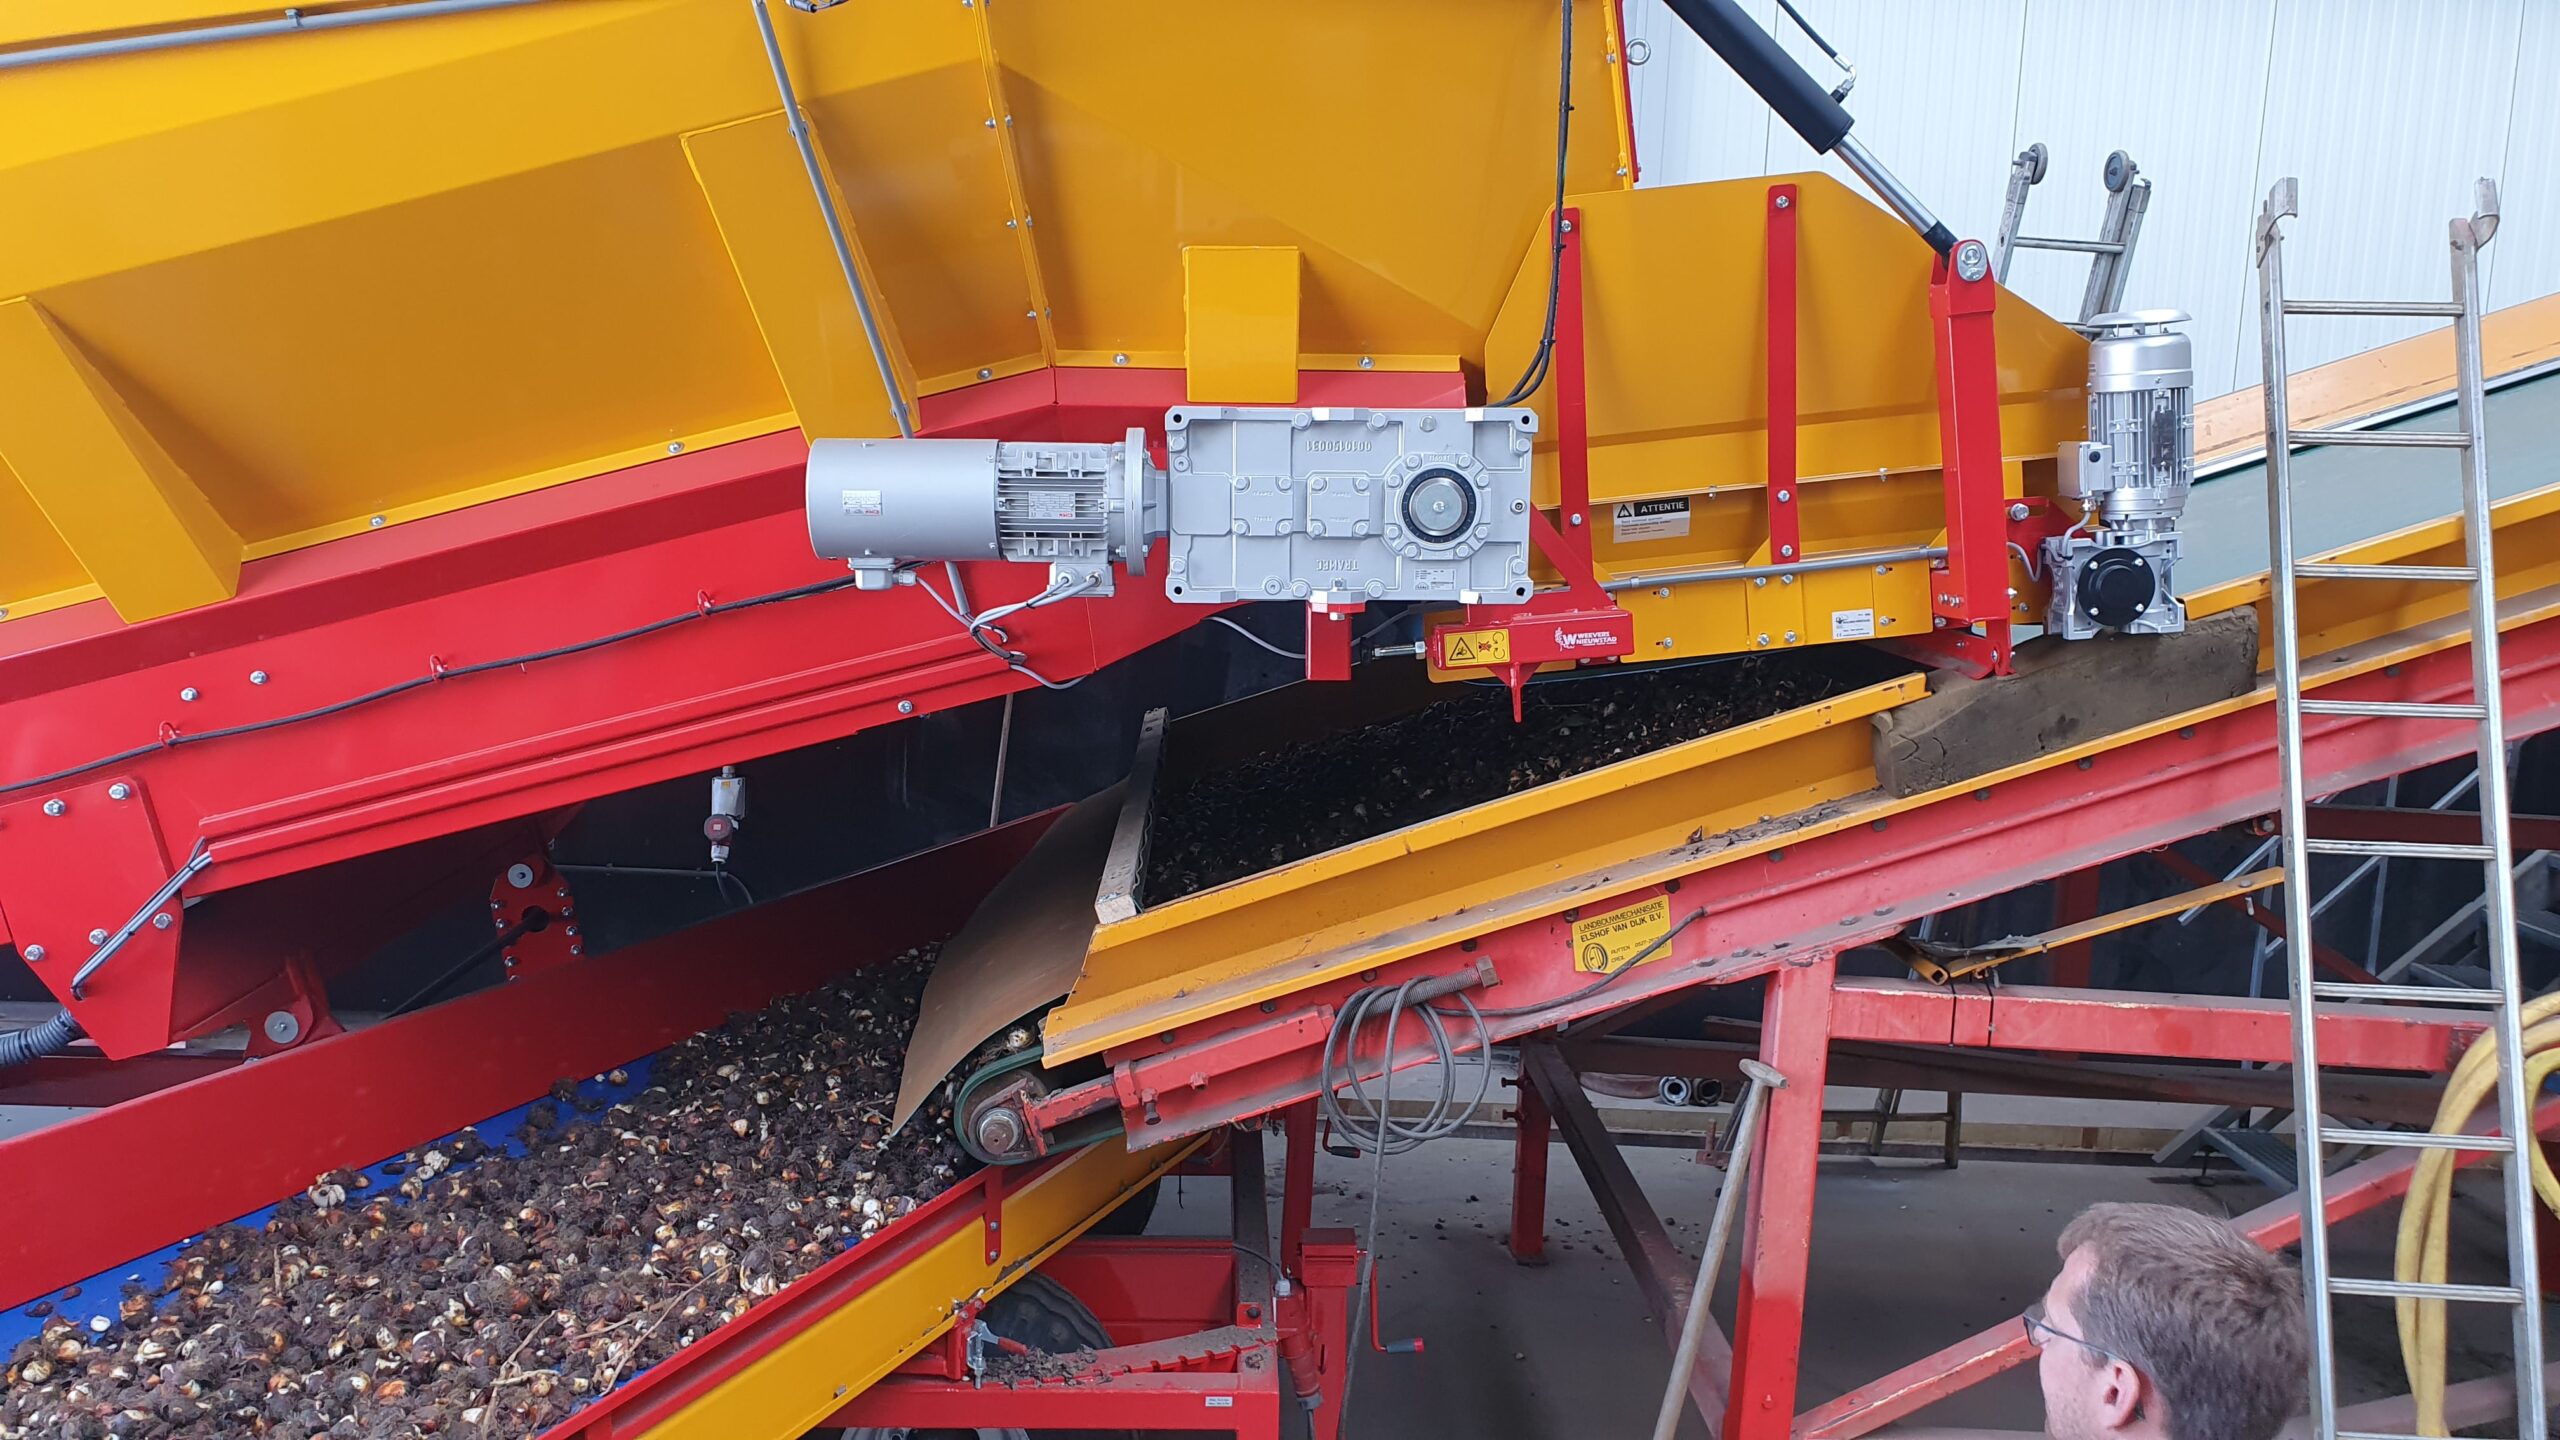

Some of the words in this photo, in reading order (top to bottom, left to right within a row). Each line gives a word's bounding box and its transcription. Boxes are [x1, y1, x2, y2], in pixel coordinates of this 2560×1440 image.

[1641, 501, 1685, 513] ATTENTIE
[1317, 560, 1359, 571] TRAMEC
[1576, 636, 1618, 645] NIEUWSTAD
[1579, 901, 1664, 932] LANDBOUWMECHANISATIE
[1580, 928, 1610, 942] ELSHOF
[1612, 923, 1628, 932] VAN
[1630, 916, 1647, 927] DIJK
[1649, 912, 1664, 922] B.V.
